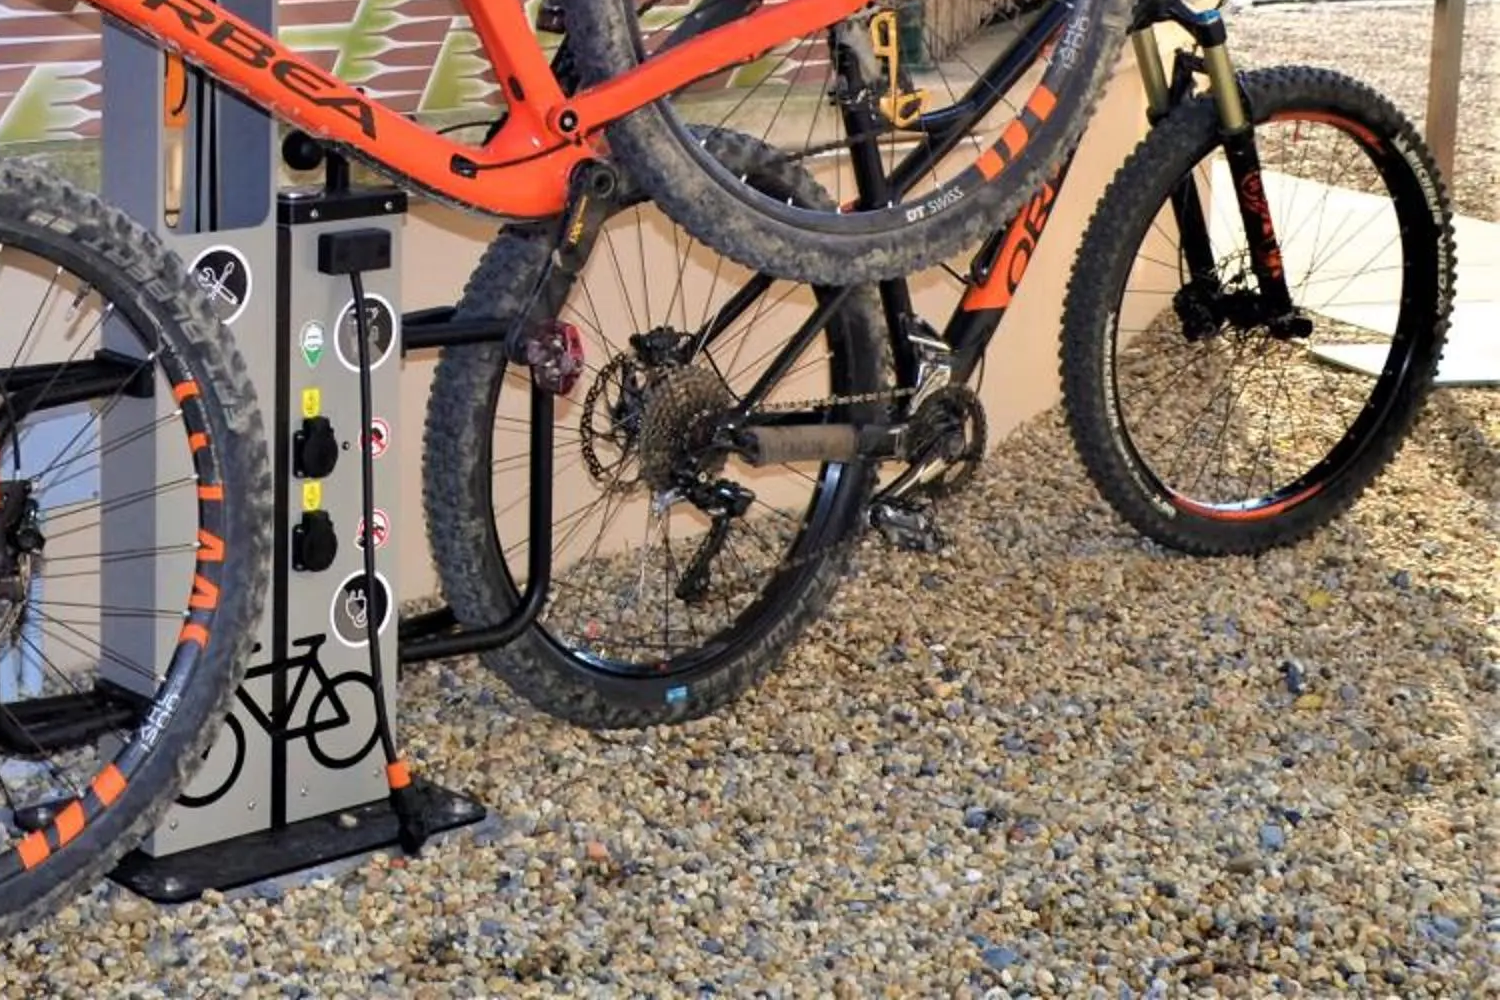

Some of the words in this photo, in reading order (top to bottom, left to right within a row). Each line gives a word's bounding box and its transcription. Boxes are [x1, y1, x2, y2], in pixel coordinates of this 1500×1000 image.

[905, 205, 925, 223] DT
[927, 185, 965, 214] SWISS
[1405, 149, 1444, 225] MICHELIN
